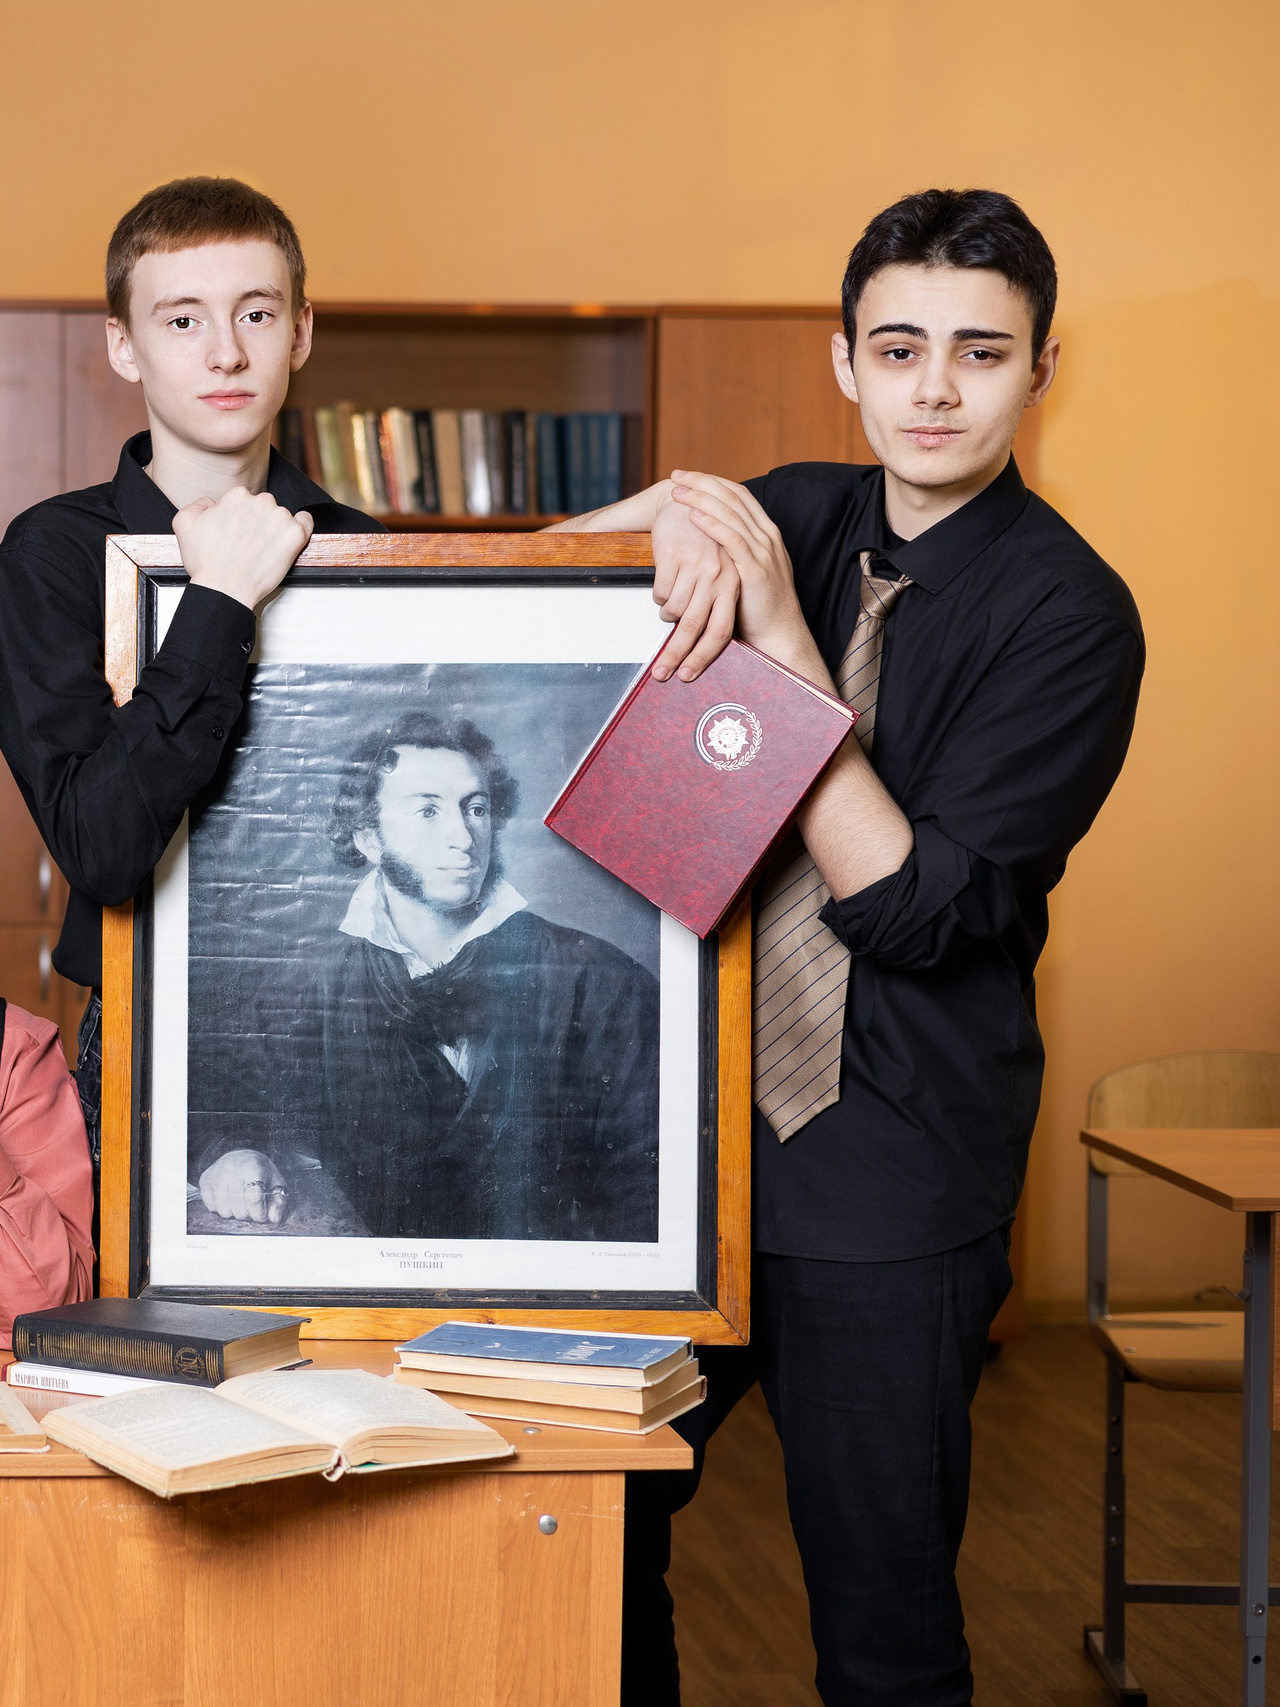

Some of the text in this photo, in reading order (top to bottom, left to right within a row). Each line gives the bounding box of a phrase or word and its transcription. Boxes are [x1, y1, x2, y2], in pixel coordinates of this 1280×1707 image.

[380, 1250, 463, 1260] Александр Сергеевич
[399, 1261, 443, 1269] ПУШКИН
[14, 1373, 69, 1389] МАРИНА ЦВЕТАЕВА
